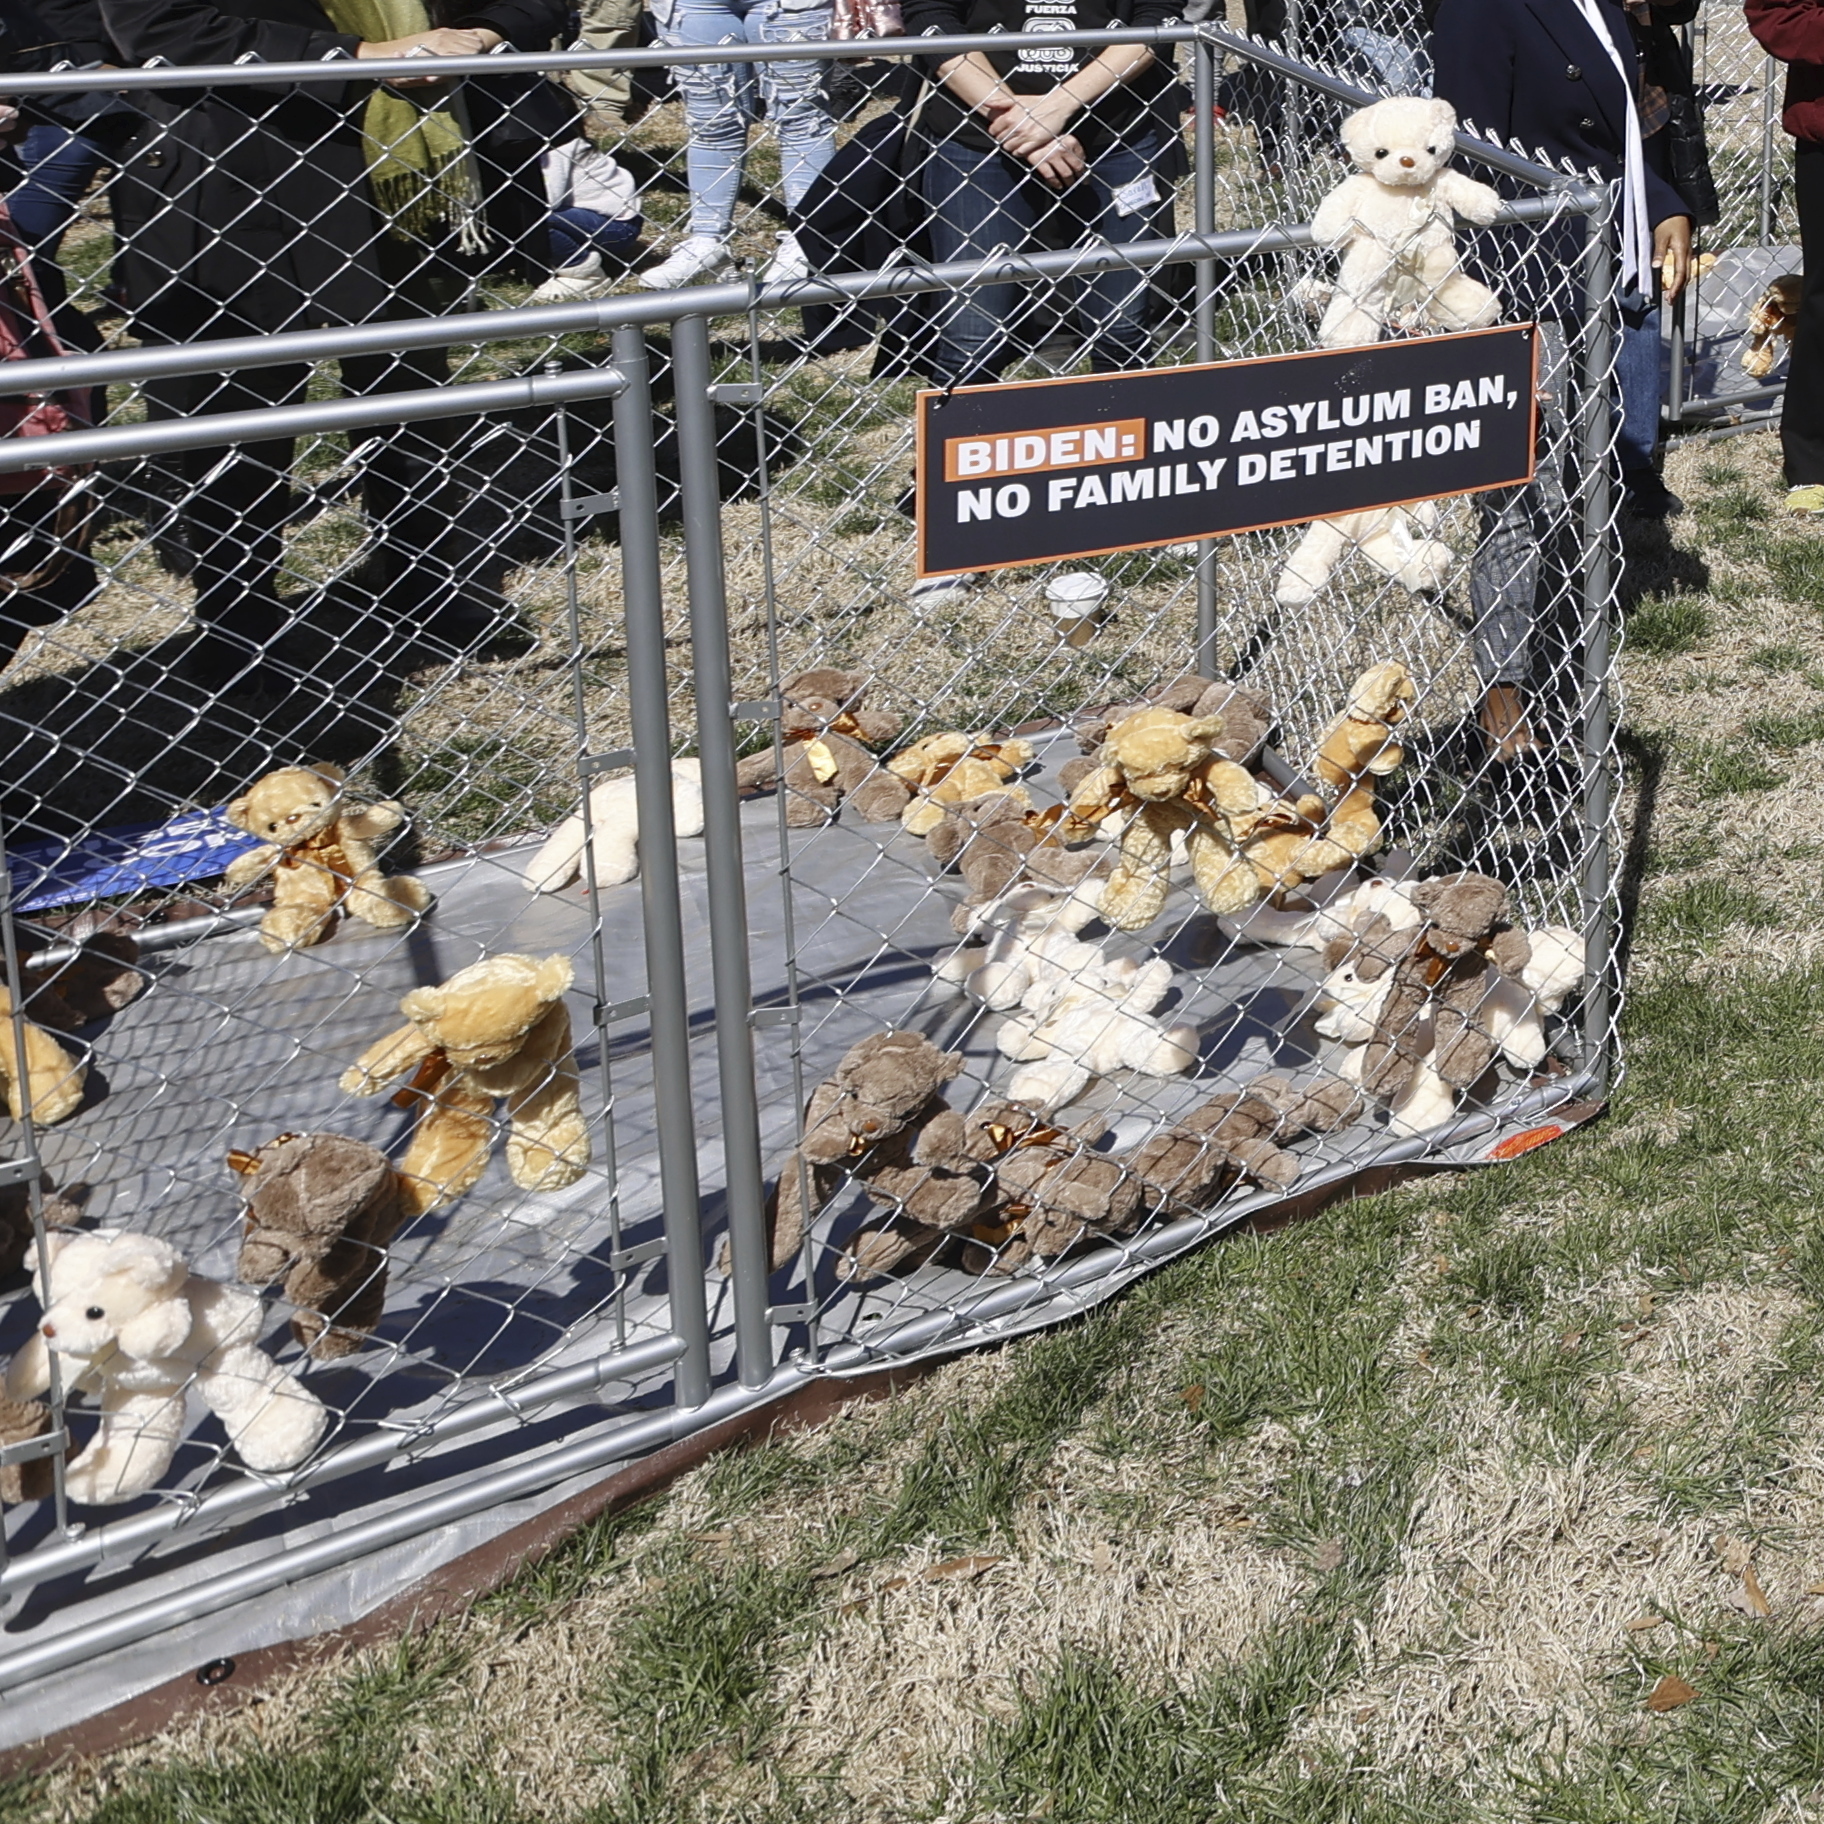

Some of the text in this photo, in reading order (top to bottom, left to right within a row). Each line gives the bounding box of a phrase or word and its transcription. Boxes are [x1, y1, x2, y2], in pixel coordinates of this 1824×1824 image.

[1025, 4, 1077, 15] FUERZA
[1016, 62, 1079, 73] JUSTICIA
[957, 375, 1518, 475] BIDEN: NO ASYLUM BAN,
[957, 420, 1482, 524] NO FAMILY DETENTION
